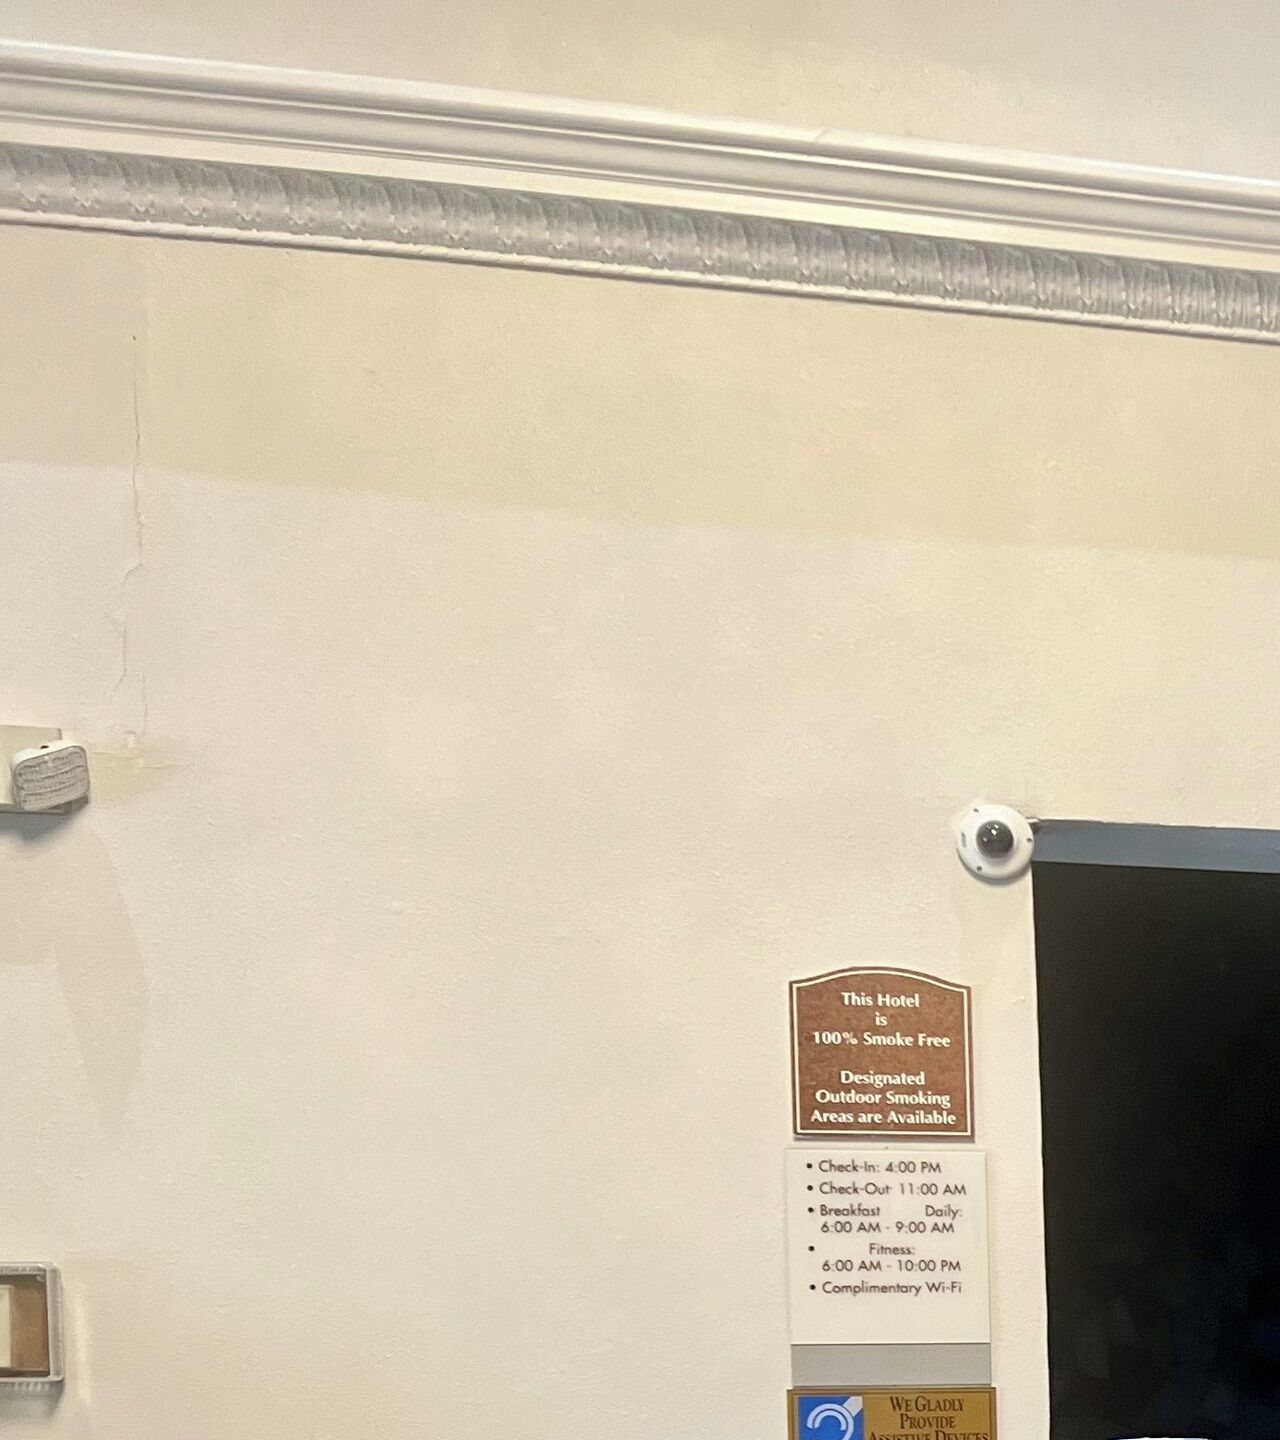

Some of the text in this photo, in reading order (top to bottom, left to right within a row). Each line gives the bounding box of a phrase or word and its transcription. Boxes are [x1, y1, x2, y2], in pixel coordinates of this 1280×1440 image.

[841, 992, 920, 1008] This Hotel
[875, 1012, 888, 1026] is
[812, 1031, 951, 1048] 100% Smoke Free
[840, 1070, 926, 1089] Designated
[815, 1089, 951, 1109] Outdoor Smoking
[810, 1109, 957, 1125] Areas are Available
[818, 1159, 942, 1174] Check-In: 4:00 PM
[900, 1182, 938, 1196] 11:00
[943, 1183, 967, 1196] AM
[820, 1203, 963, 1221] Breakfast Daily:
[820, 1221, 853, 1234] 6:00
[857, 1222, 881, 1234] AM
[895, 1221, 926, 1234] 9:00
[930, 1222, 955, 1234] AM
[869, 1243, 916, 1256] Fitness:
[822, 1259, 853, 1272] 6:00
[857, 1260, 882, 1272] AM
[898, 1259, 936, 1272] 10:00
[940, 1259, 961, 1272] PM
[822, 1280, 962, 1297] Complimentary Wi-Fi
